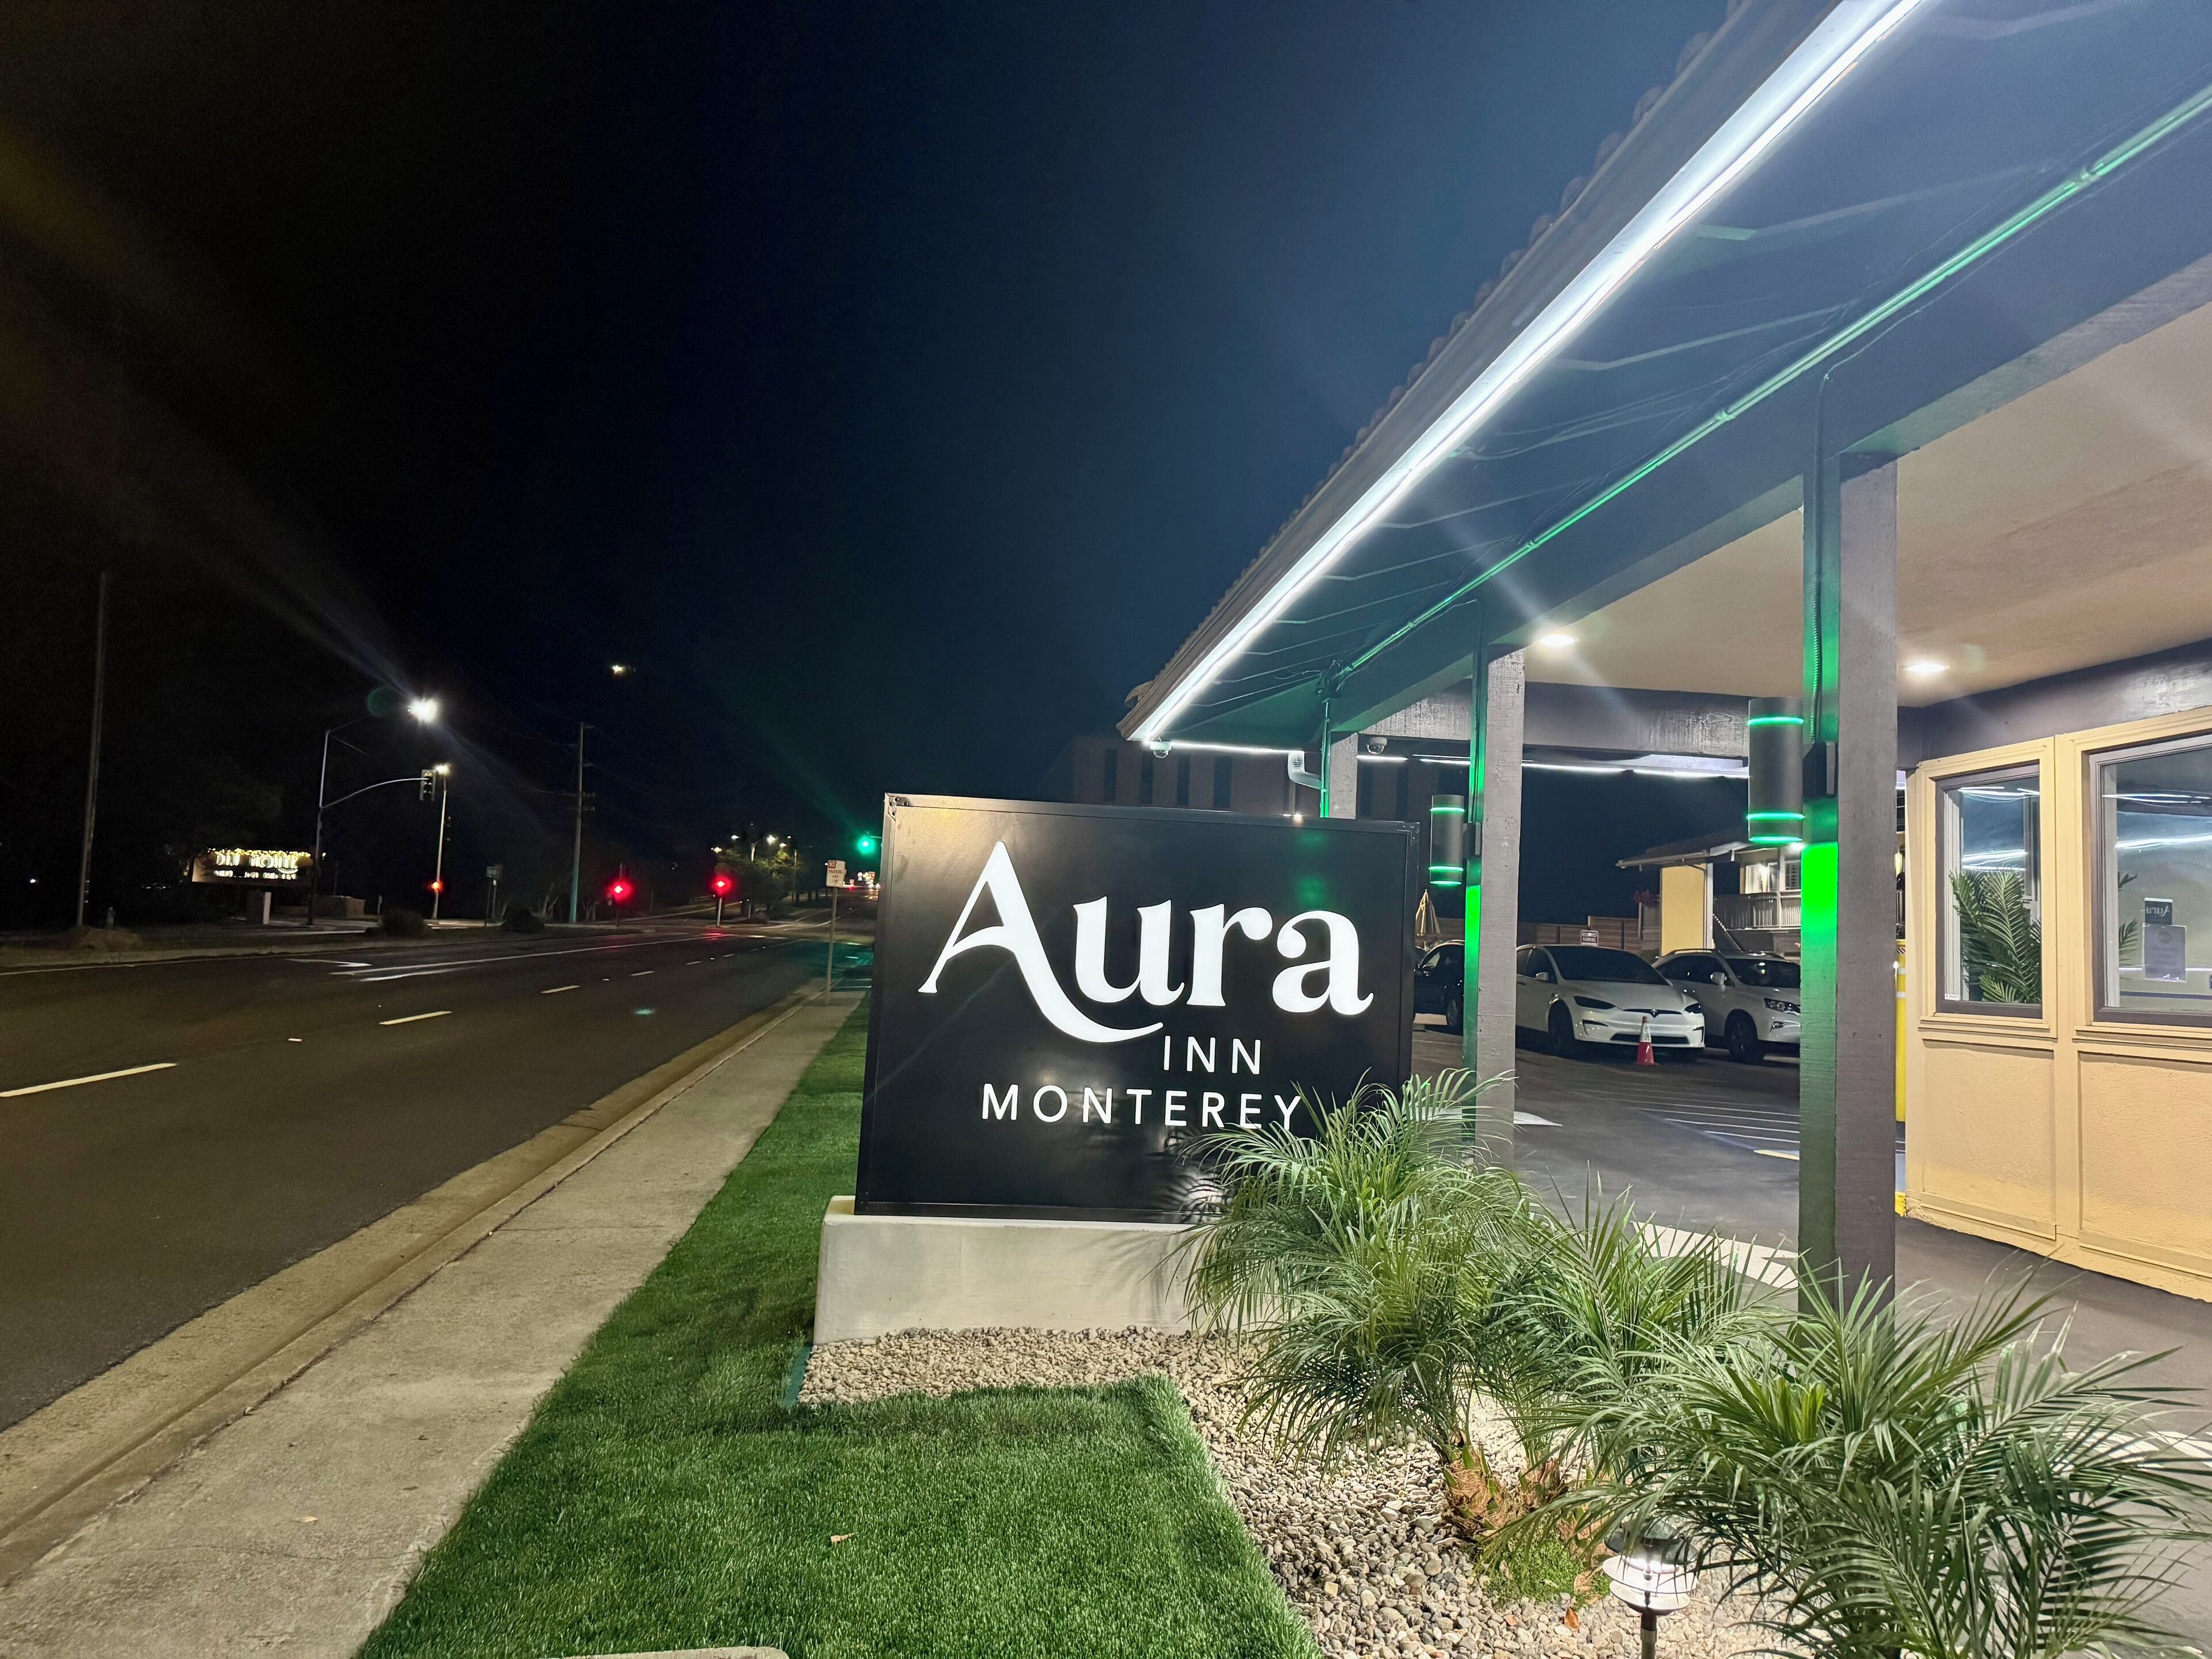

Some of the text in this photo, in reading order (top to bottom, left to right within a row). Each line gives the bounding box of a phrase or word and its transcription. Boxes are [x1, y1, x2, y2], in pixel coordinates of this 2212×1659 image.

[918, 840, 1374, 1043] Aura
[1164, 1035, 1262, 1074] INN
[982, 1083, 1301, 1131] MONTEREY
